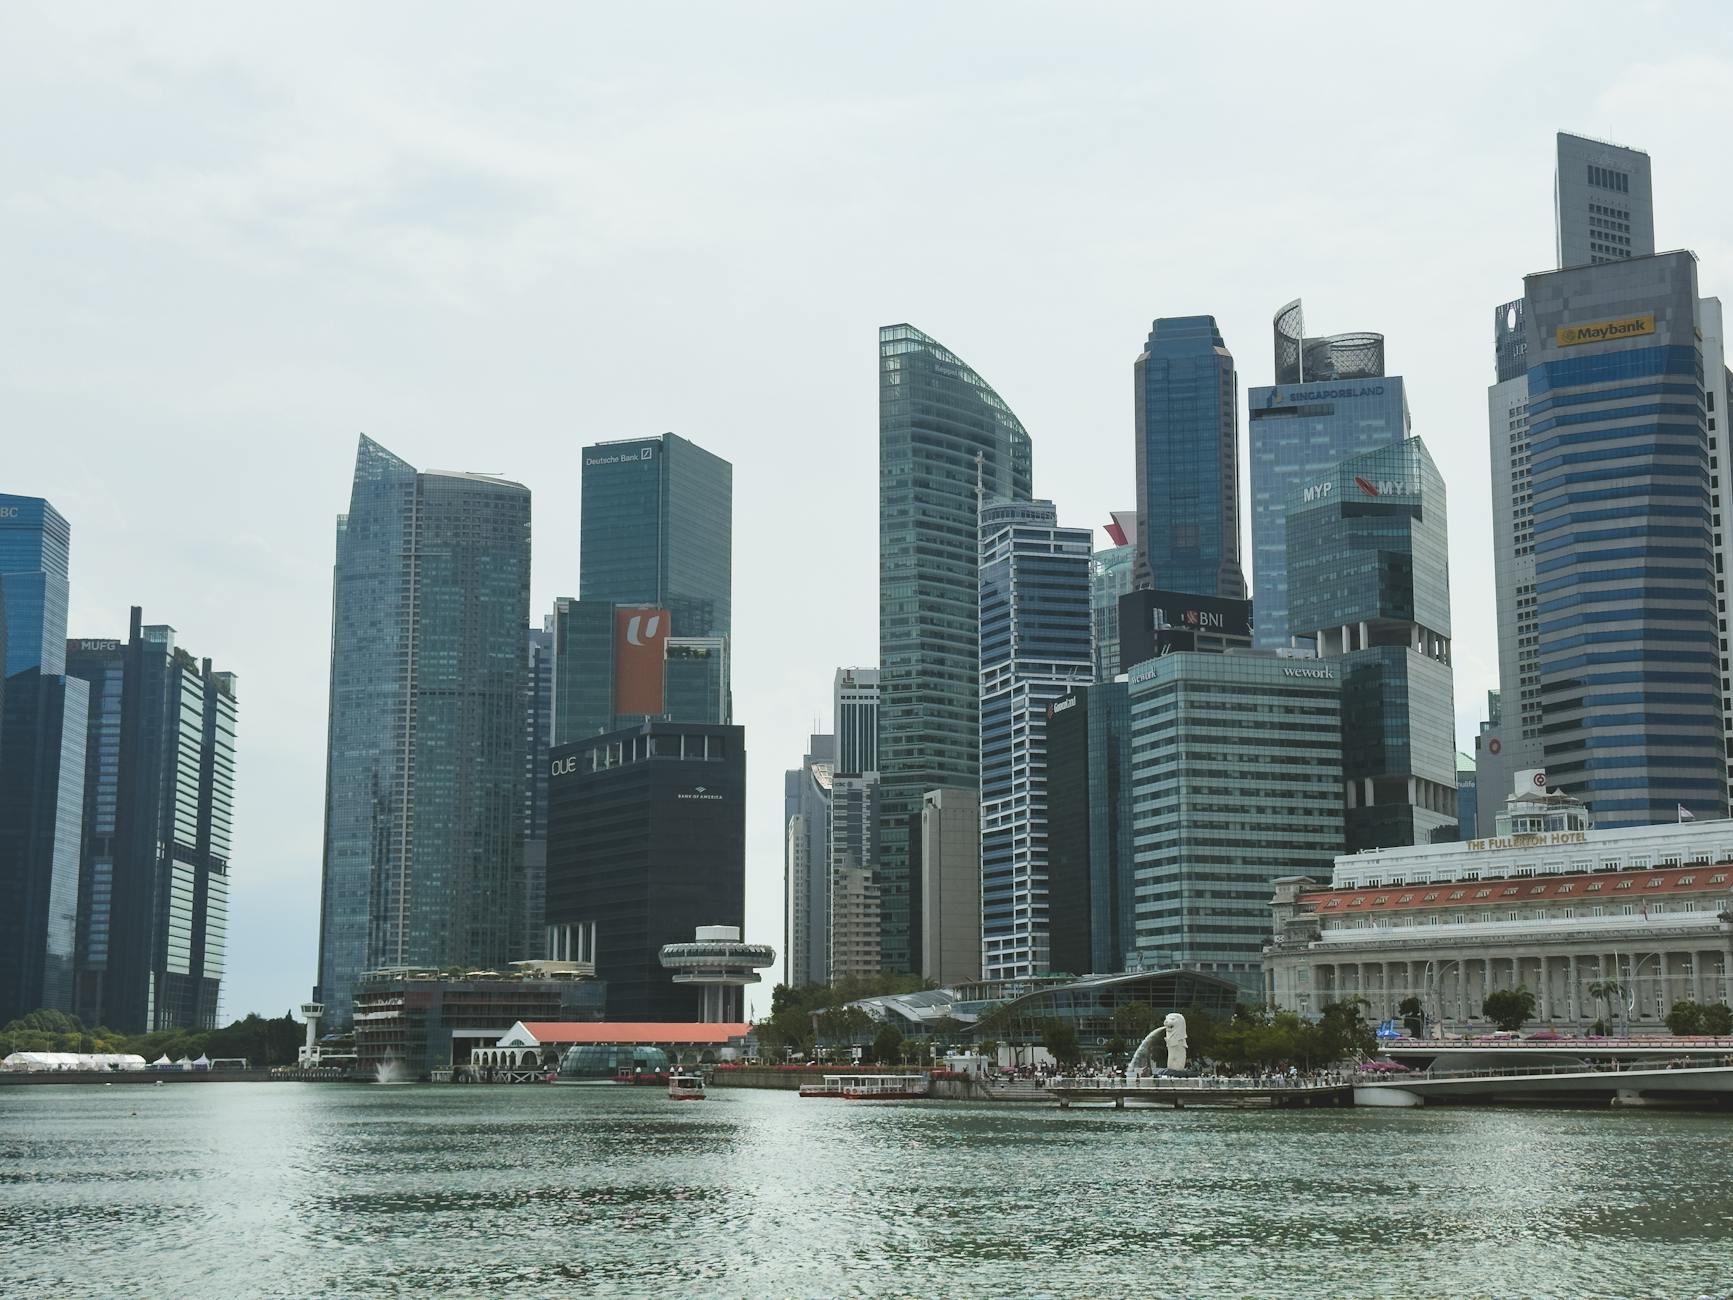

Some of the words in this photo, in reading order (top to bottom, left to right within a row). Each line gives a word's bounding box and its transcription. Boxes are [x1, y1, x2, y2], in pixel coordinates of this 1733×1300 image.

[1577, 319, 1646, 340] Maybank
[1289, 386, 1385, 402] SINGAPORELAND
[586, 455, 619, 466] Deutsche
[620, 453, 639, 463] Bank
[1303, 482, 1332, 502] MYP
[1379, 481, 1420, 495] MYP
[1199, 611, 1224, 628] BNI
[81, 641, 116, 651] MUFG
[1283, 665, 1334, 679] wework
[551, 756, 577, 776] OUE
[1466, 841, 1485, 850] THE
[1488, 834, 1547, 849] FULLERTON
[1551, 831, 1585, 845] HOTEL
